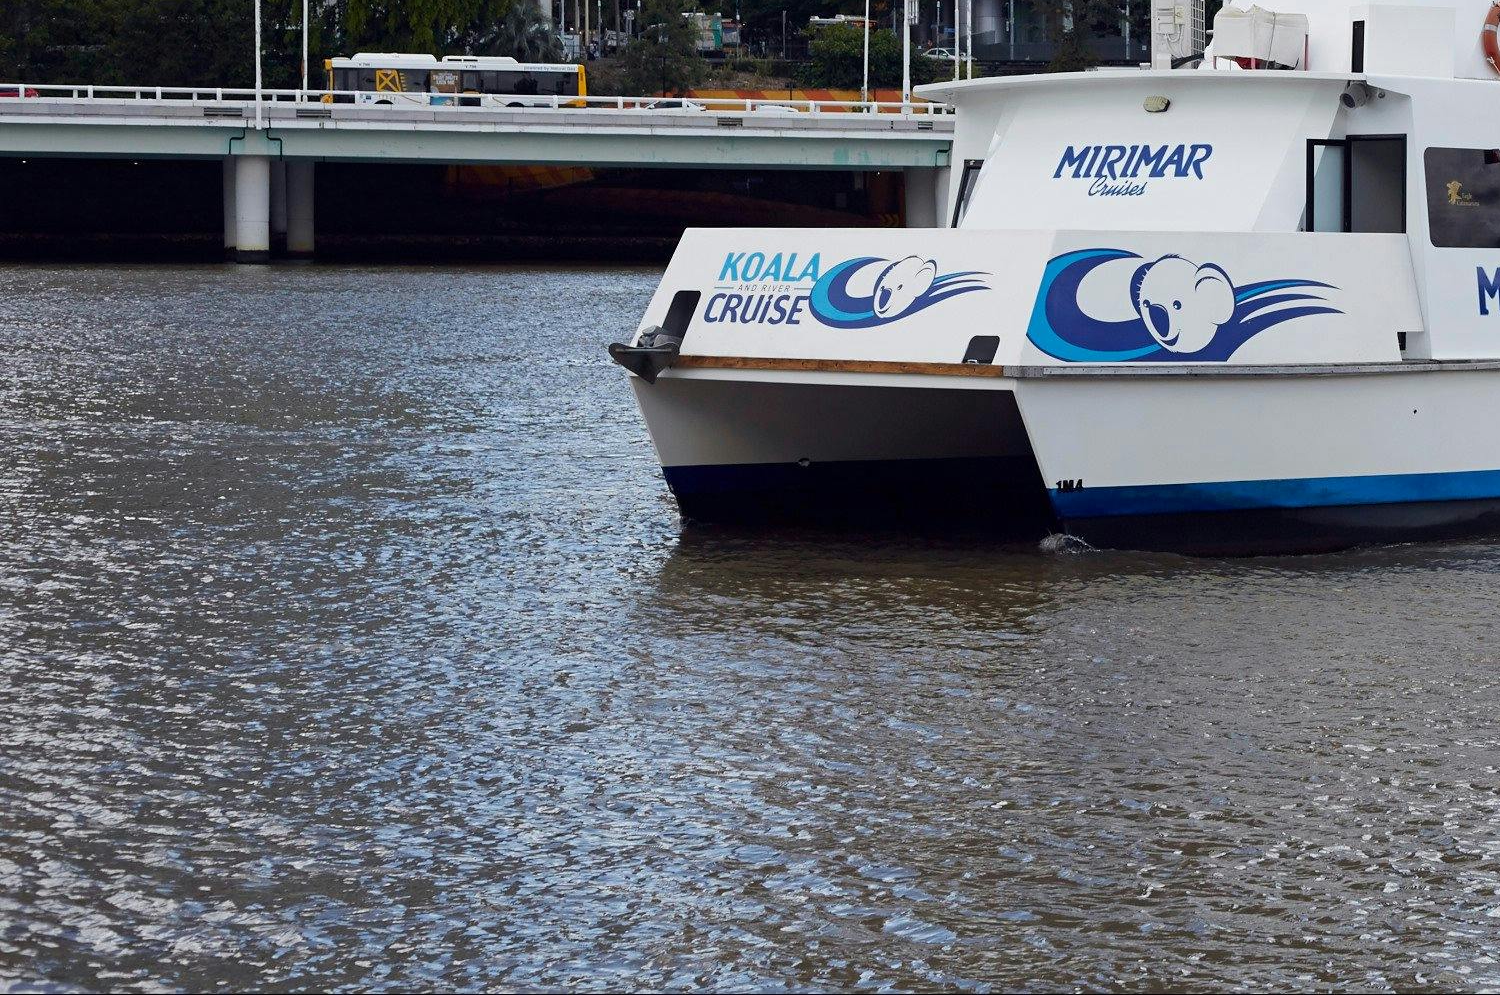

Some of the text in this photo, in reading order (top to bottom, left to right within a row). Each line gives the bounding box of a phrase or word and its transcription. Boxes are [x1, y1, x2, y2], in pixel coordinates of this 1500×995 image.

[1053, 144, 1213, 180] MIRIMAR
[1088, 174, 1148, 196] Cruises
[718, 251, 821, 282] KOALA
[738, 284, 791, 293] AND RIVER
